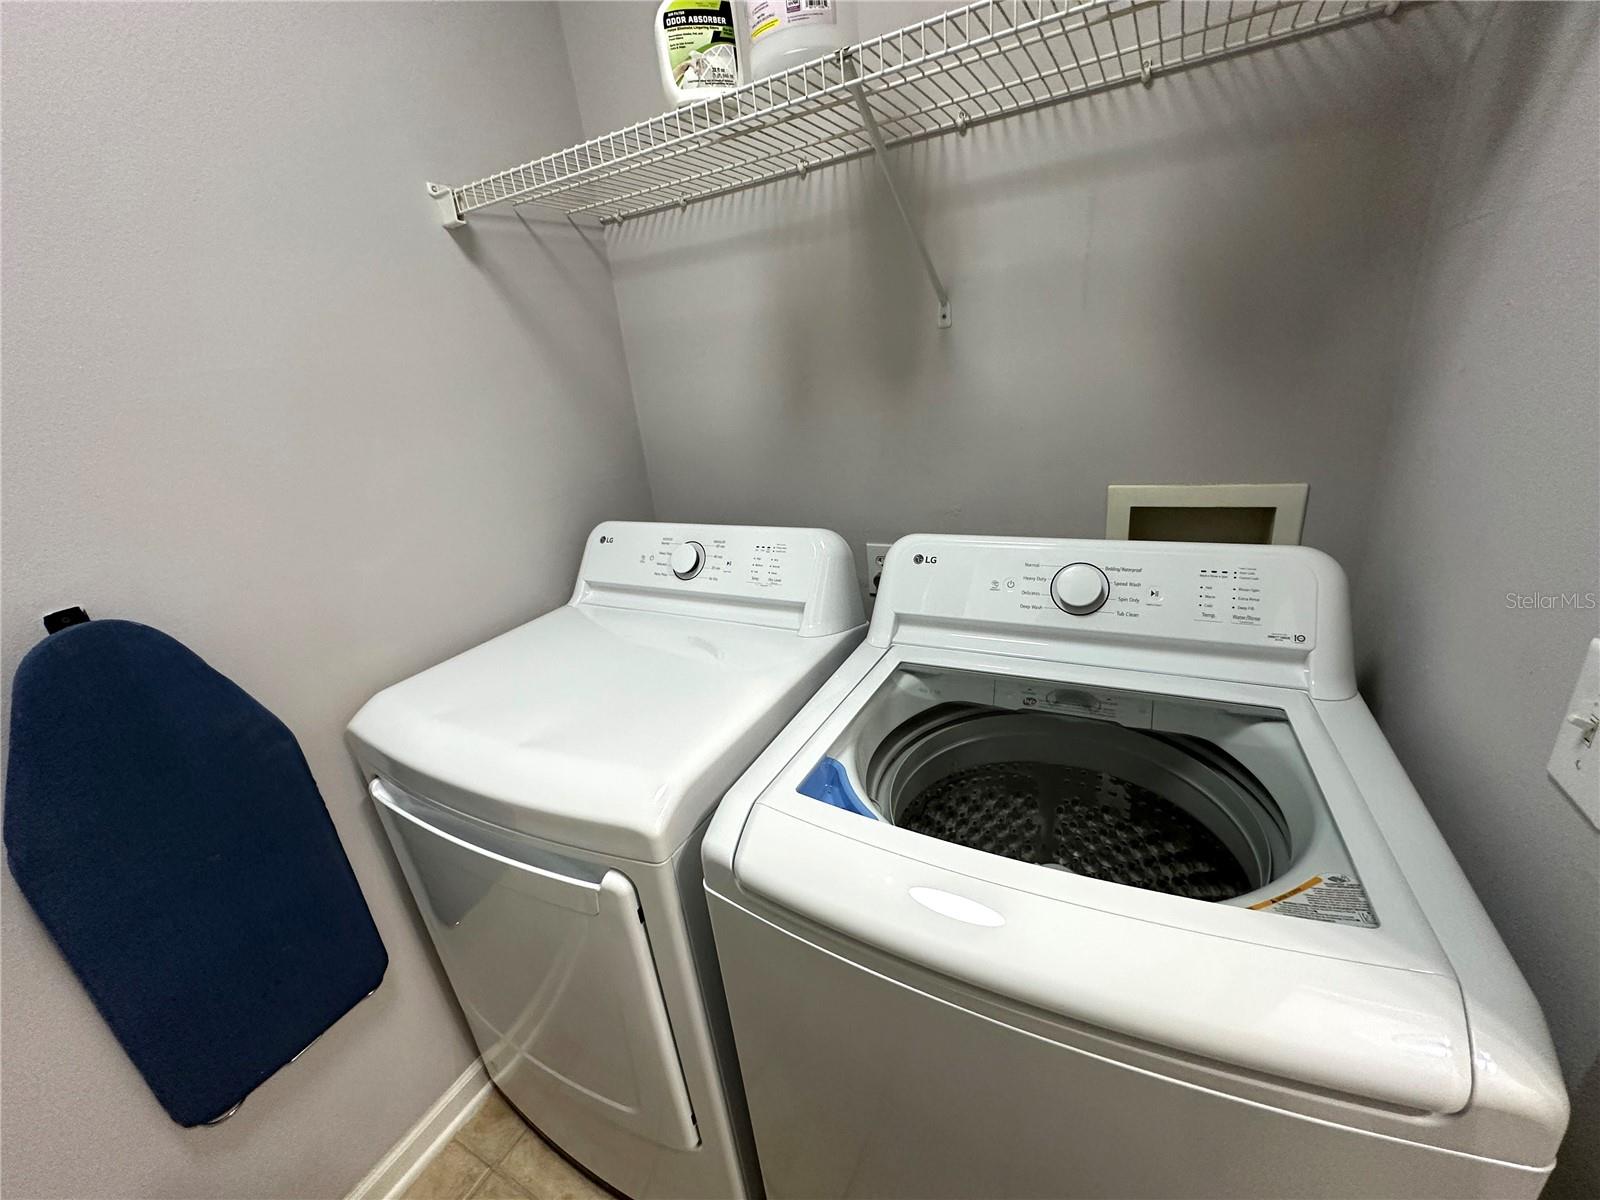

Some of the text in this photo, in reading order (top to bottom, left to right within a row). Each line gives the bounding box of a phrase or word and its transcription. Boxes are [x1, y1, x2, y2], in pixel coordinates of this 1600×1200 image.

[666, 15, 727, 26] ODOR ABSORBER
[925, 556, 937, 564] LG
